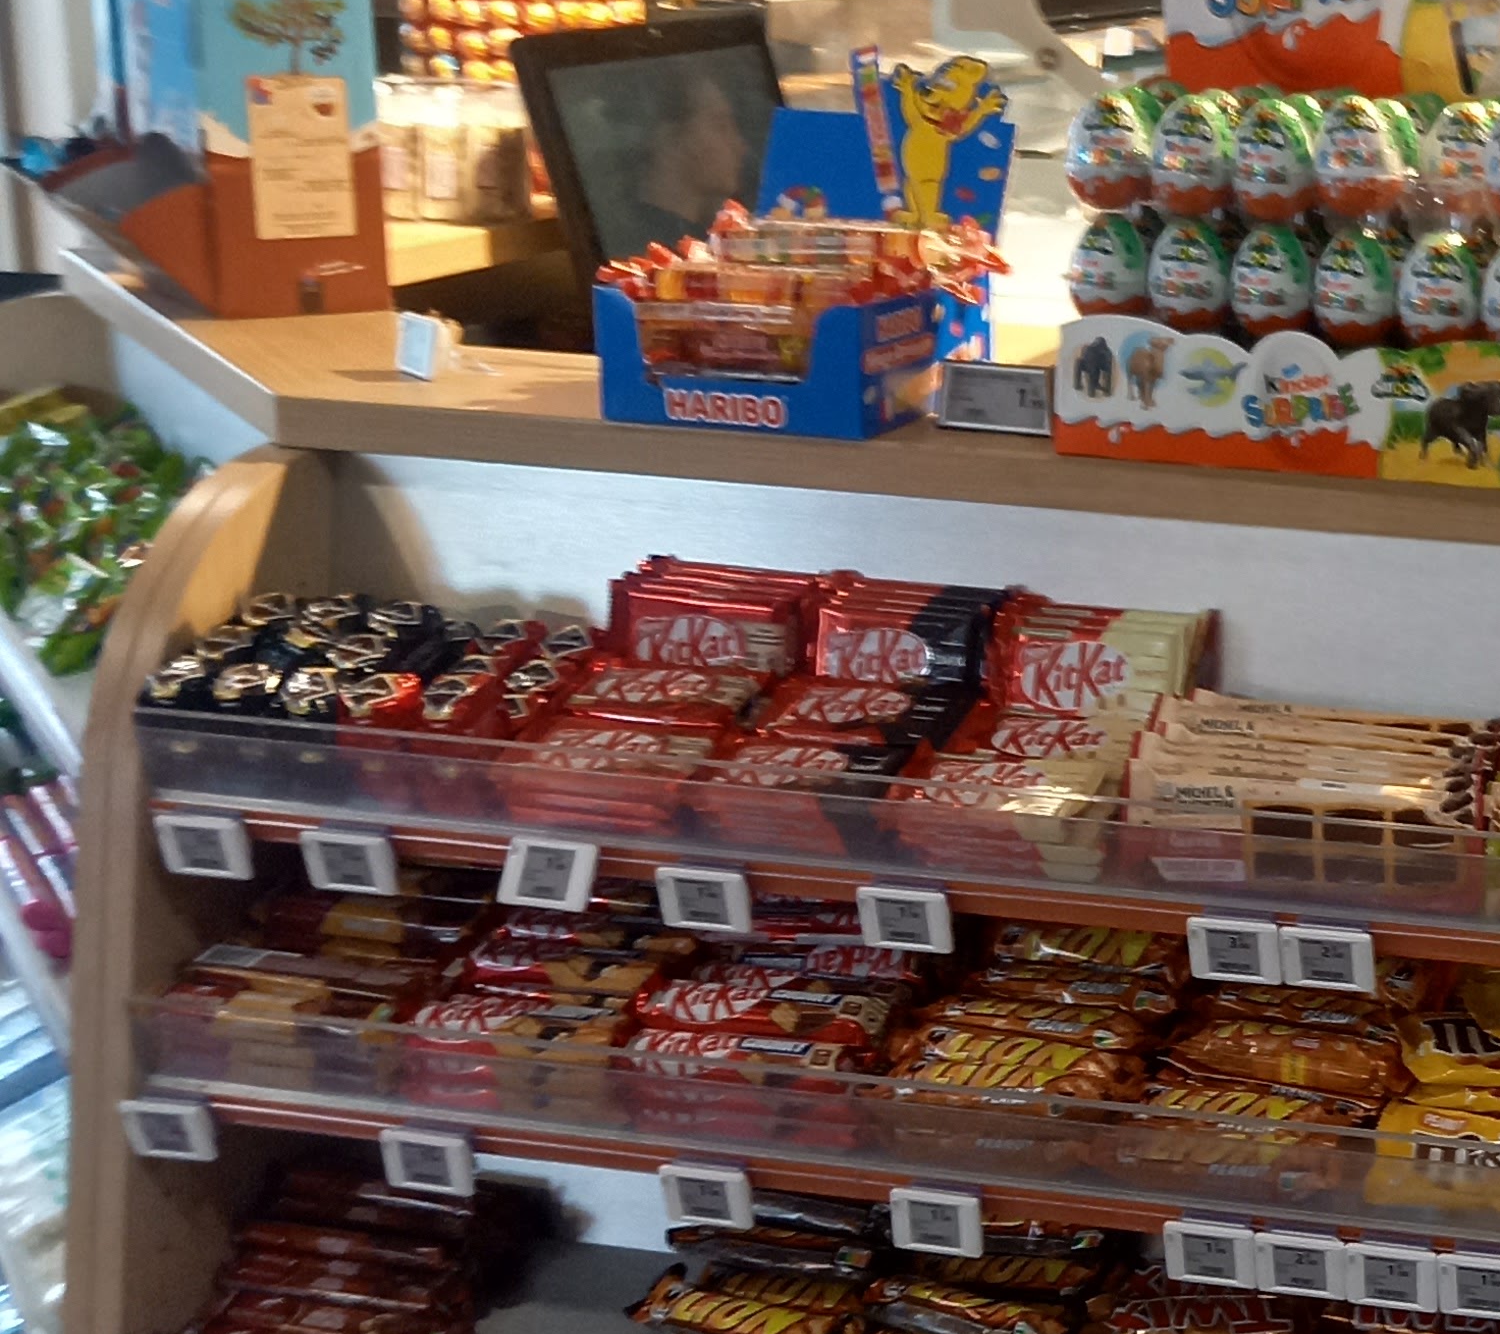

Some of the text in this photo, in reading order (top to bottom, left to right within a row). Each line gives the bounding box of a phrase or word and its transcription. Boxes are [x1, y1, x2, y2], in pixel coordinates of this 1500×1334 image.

[666, 388, 785, 429] HARIBO
[1242, 383, 1361, 427] SURPRISE
[1018, 641, 1129, 711] KitKat
[990, 719, 1107, 760] KitKat
[665, 980, 769, 1023] KitKat
[942, 1033, 1092, 1067] LION
